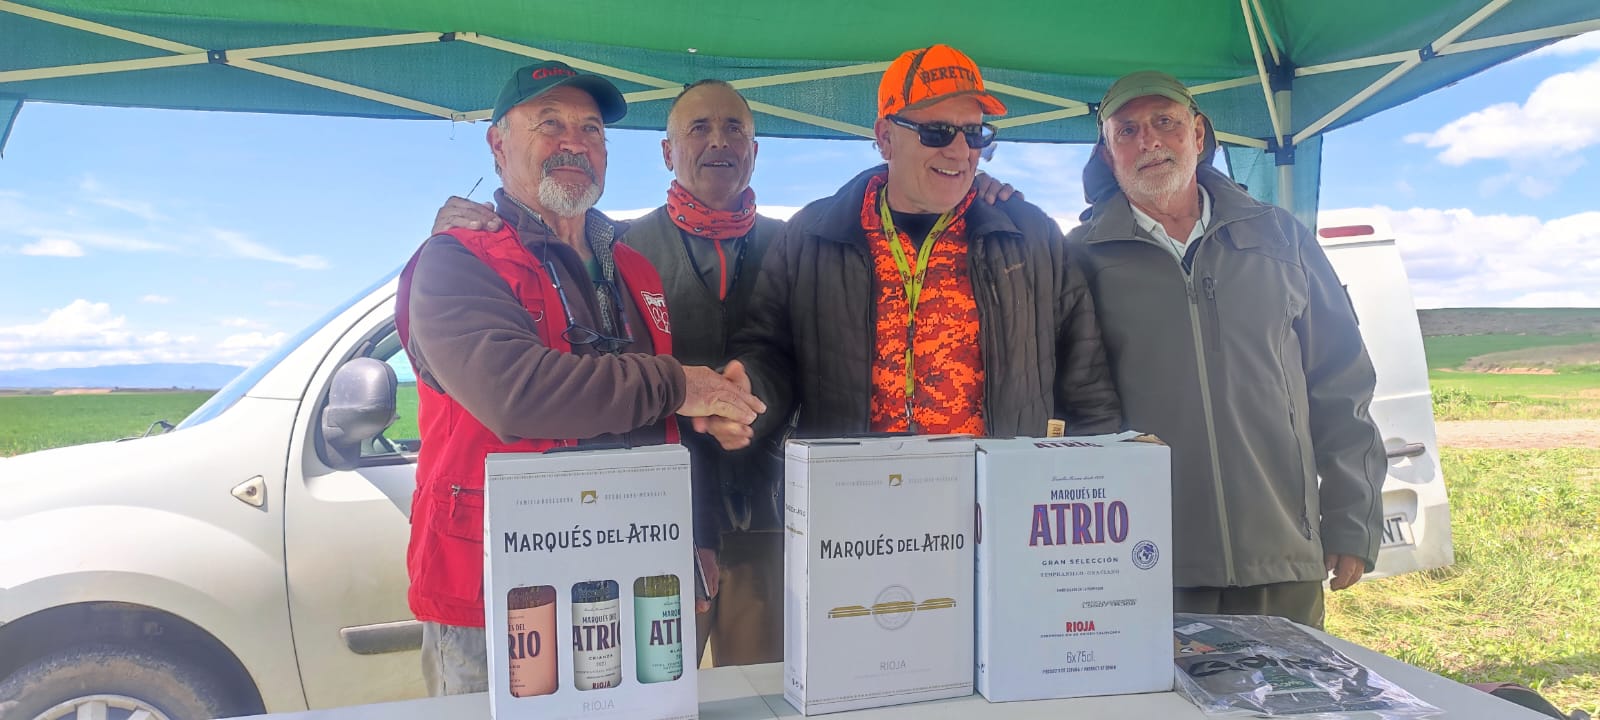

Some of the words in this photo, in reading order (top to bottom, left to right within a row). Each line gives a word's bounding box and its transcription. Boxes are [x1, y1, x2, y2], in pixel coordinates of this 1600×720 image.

[1050, 487, 1090, 501] MARQUÉS
[1092, 488, 1106, 499] DEL
[1029, 500, 1129, 546] ATRIO
[504, 525, 592, 553] MARQUÉS
[597, 529, 624, 545] DEL
[626, 523, 680, 544] ATRIO
[820, 534, 893, 560] MARQUÉS
[897, 538, 920, 553] DEL
[921, 533, 964, 552] ATRIO
[1065, 620, 1096, 633] RIOJA
[879, 659, 906, 671] RIOJA
[592, 680, 611, 689] RIOJA
[582, 699, 615, 712] RIOJA
